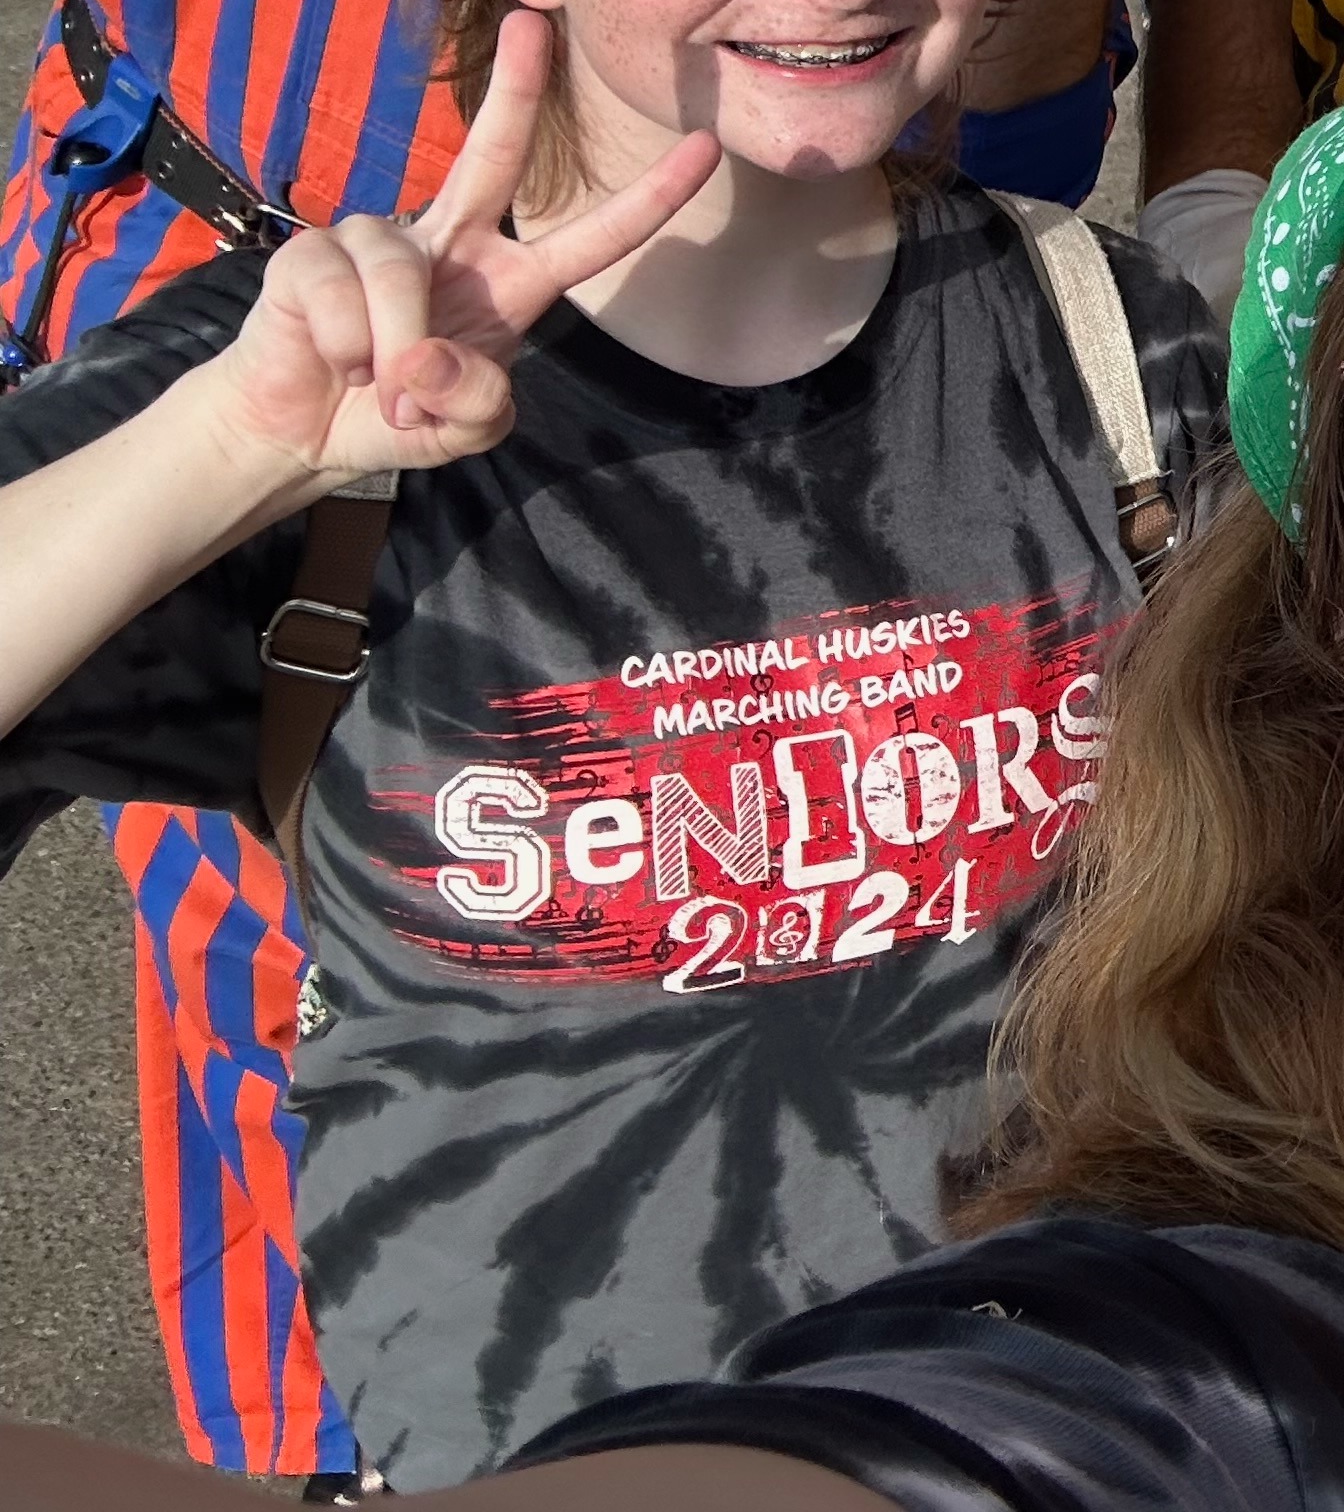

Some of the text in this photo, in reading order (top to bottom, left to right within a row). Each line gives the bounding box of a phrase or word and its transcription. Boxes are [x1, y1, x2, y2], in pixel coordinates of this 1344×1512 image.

[619, 608, 971, 689] CARDINAL HUSKIES
[652, 659, 964, 740] MARCHING BAND
[662, 857, 978, 995] 2024
